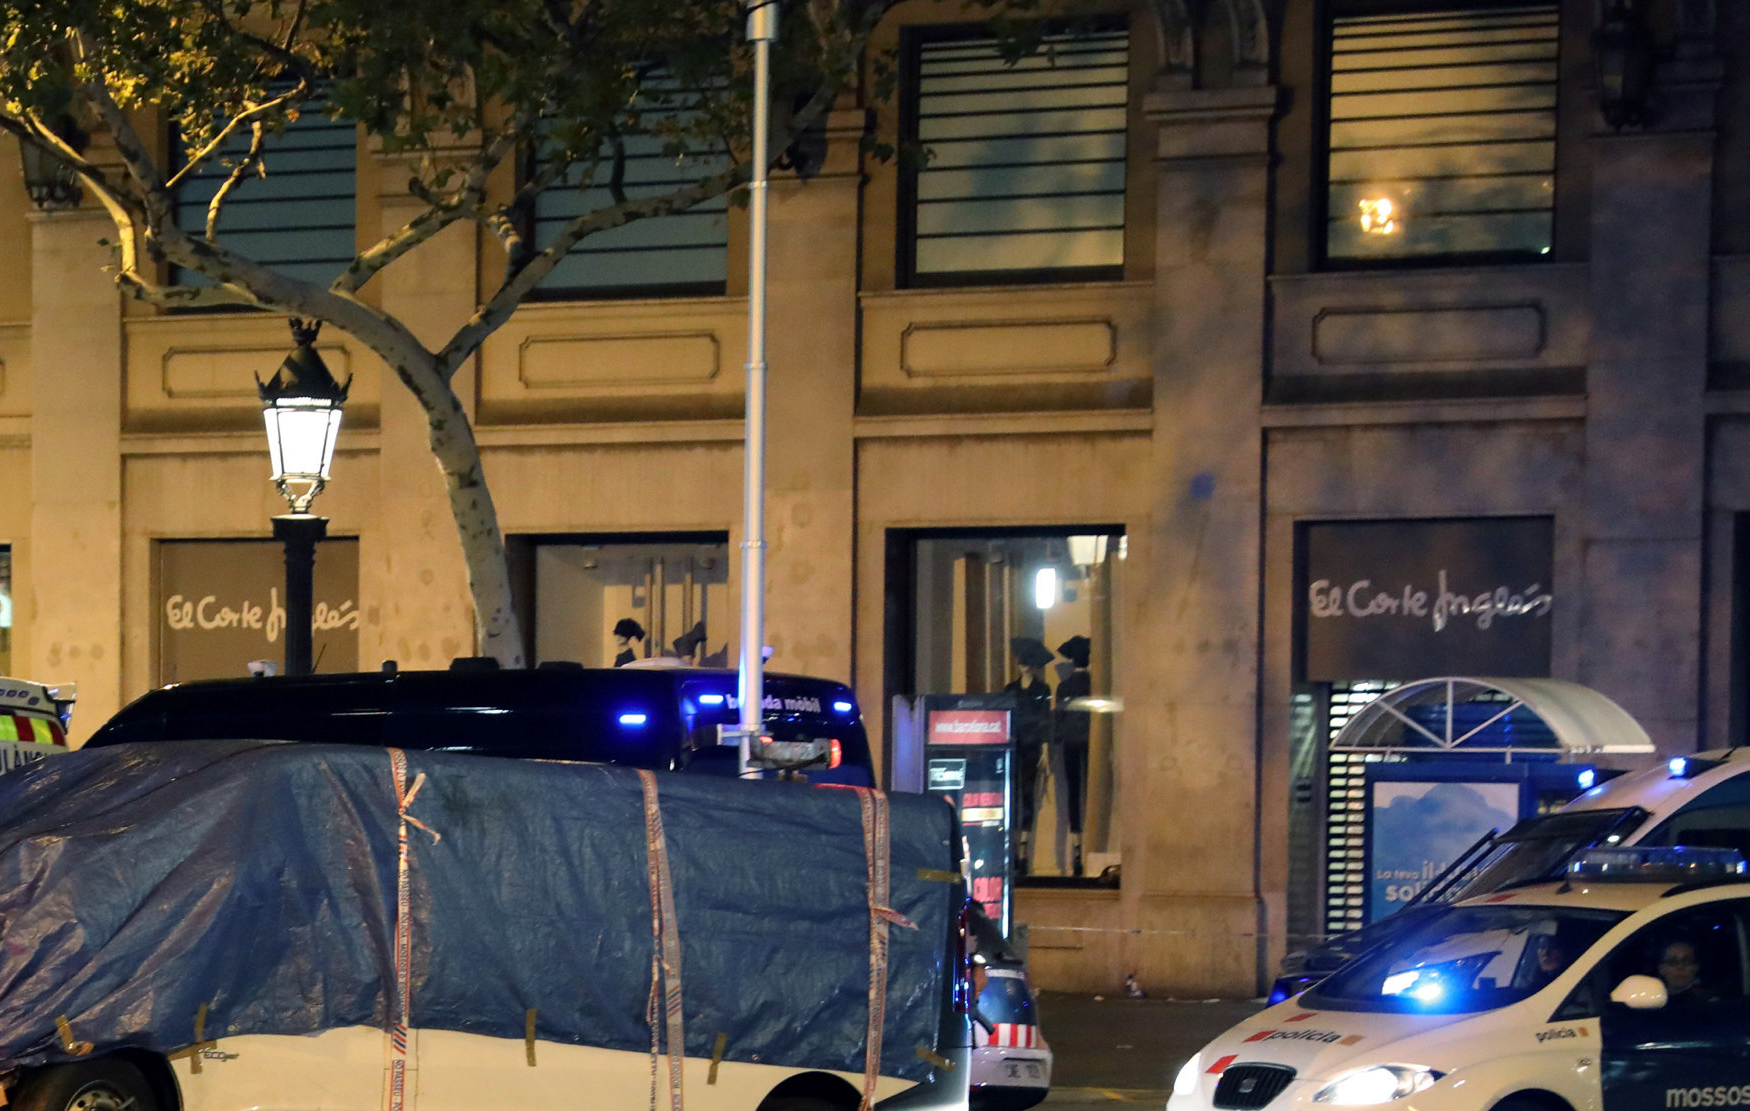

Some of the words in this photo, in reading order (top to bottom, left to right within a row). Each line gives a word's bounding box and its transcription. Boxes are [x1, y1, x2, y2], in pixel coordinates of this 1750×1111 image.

[166, 595, 194, 630] El
[197, 596, 263, 630] Corte
[1309, 579, 1344, 617] El
[1347, 580, 1429, 617] Corte
[1432, 569, 1552, 632] Inglés
